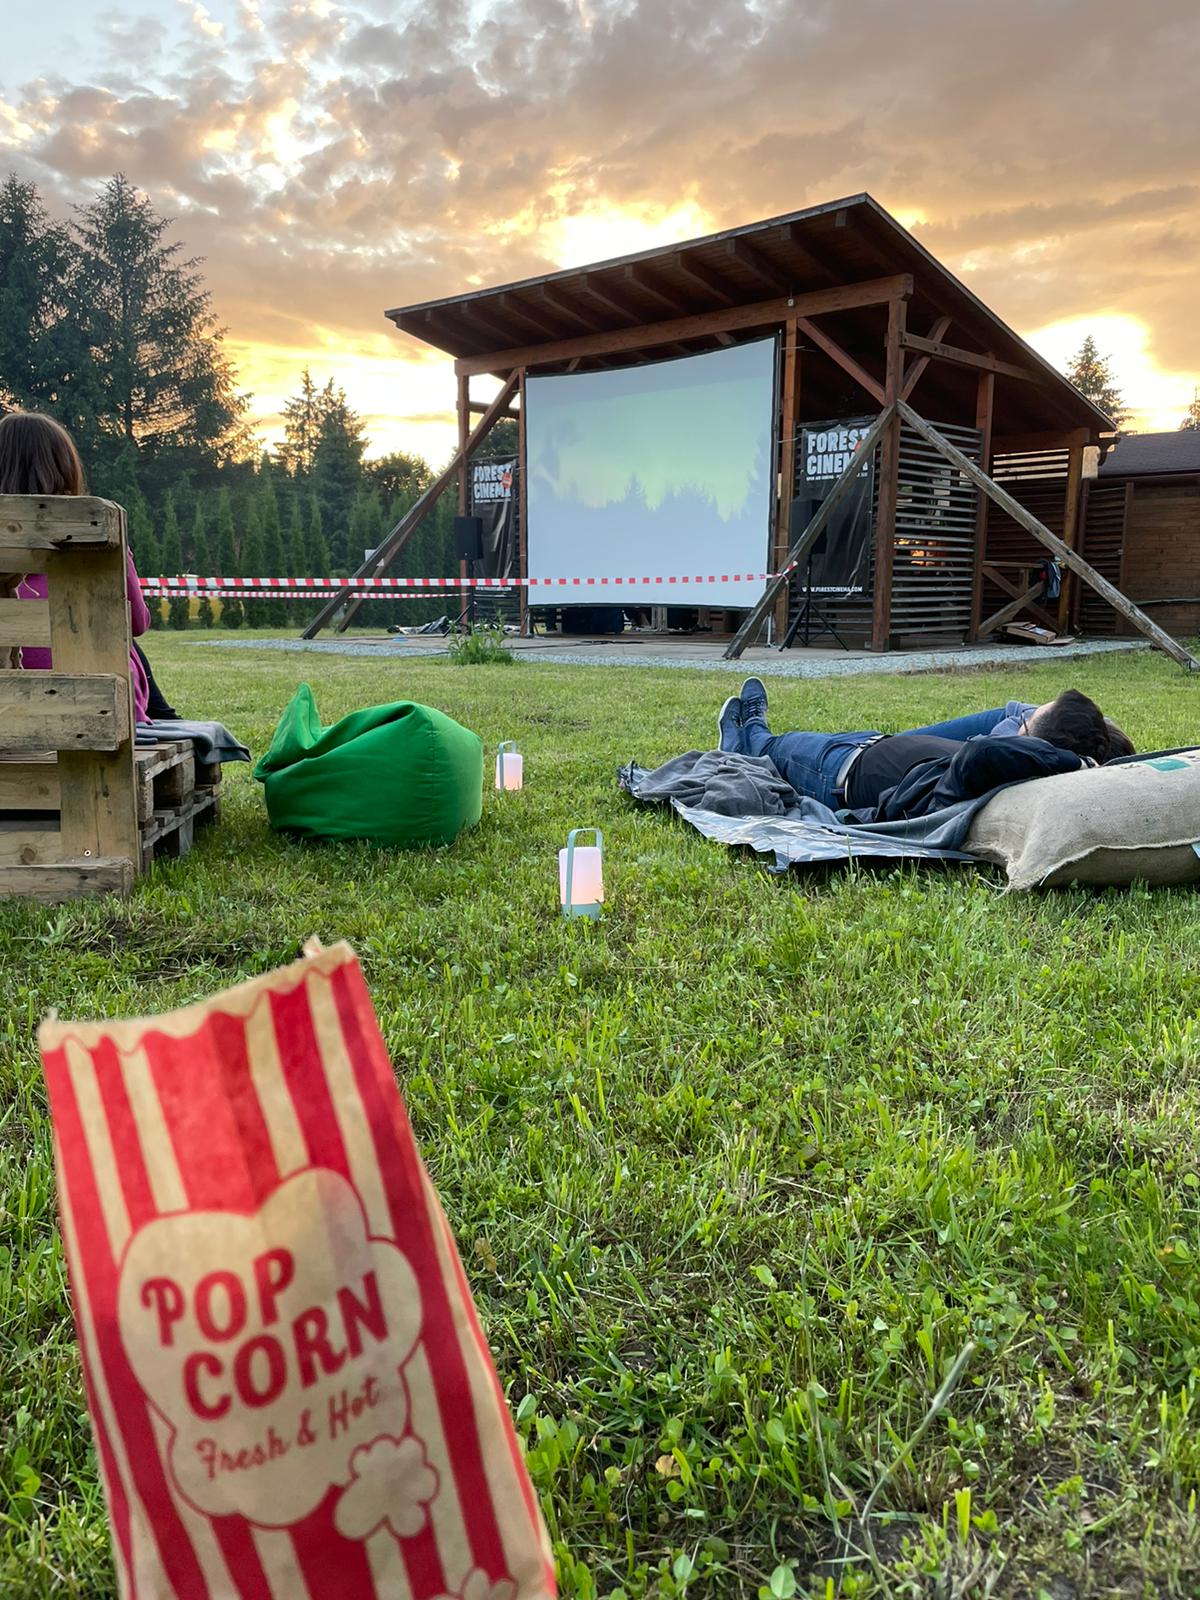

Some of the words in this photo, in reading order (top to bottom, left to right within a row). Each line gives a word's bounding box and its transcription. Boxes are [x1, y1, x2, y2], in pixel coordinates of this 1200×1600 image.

[806, 451, 868, 476] CINEM
[808, 428, 870, 454] FOREST
[140, 1248, 295, 1347] POP
[183, 1270, 389, 1420] CORN
[196, 1427, 290, 1481] Fresh
[297, 1408, 316, 1447] &
[328, 1376, 380, 1440] Hot
